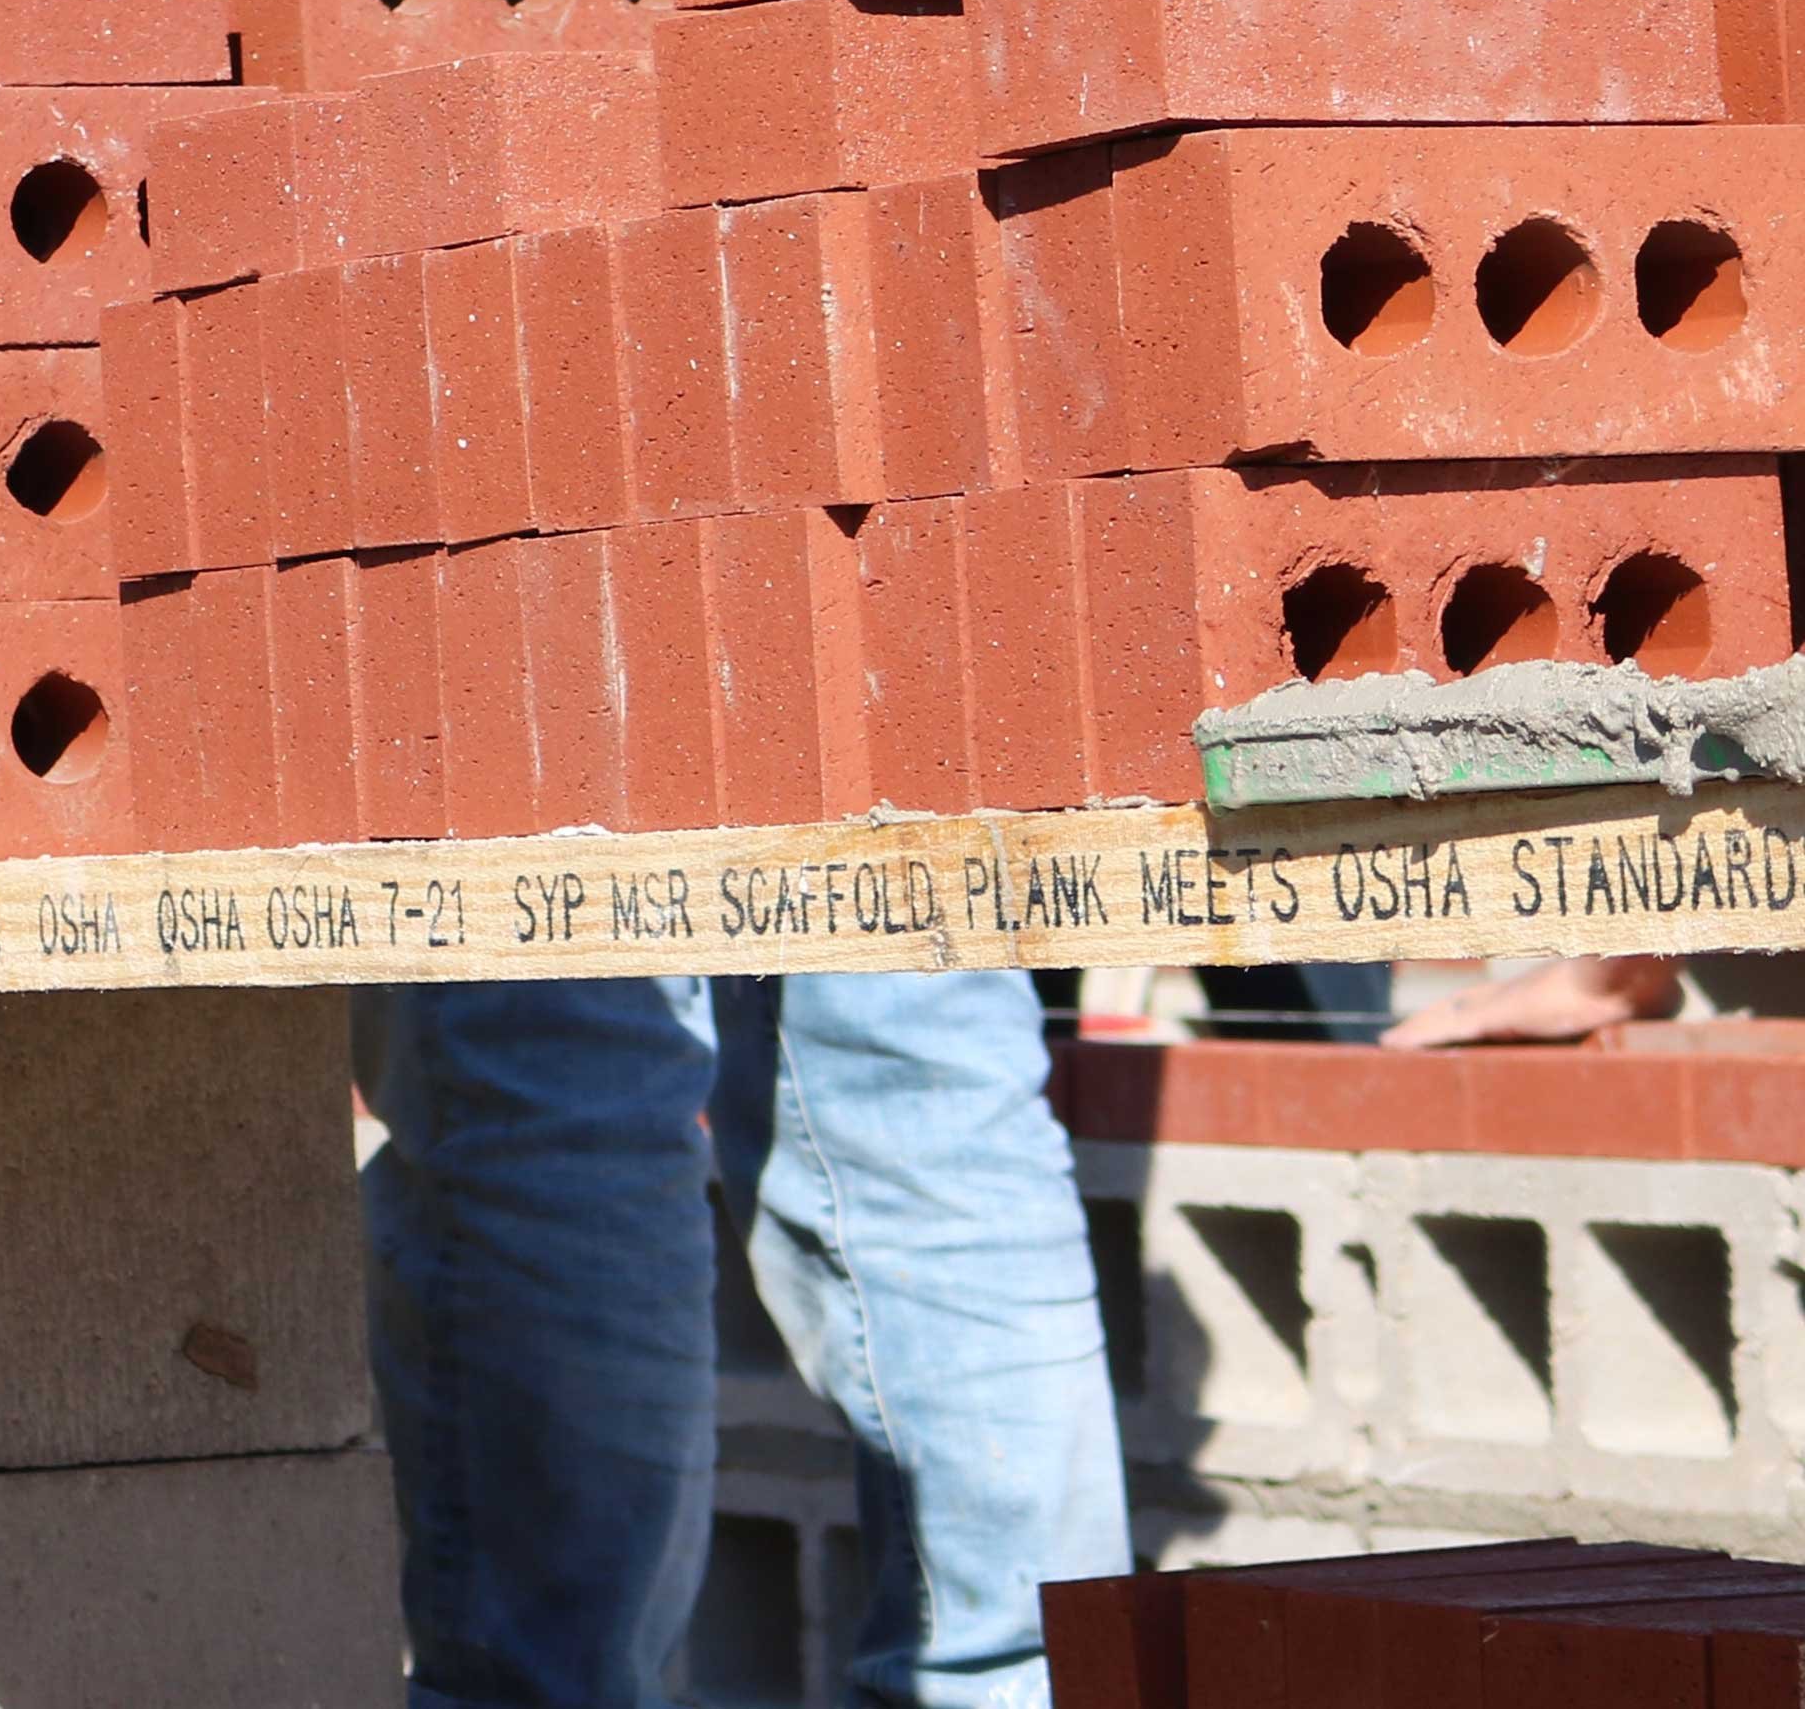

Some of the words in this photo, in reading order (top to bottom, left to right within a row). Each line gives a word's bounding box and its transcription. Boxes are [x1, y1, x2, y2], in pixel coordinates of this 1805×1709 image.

[39, 892, 121, 955] OSHA
[156, 887, 245, 955] OSHA
[267, 882, 359, 948] OSHA
[382, 877, 467, 947] 7-21
[513, 871, 586, 943] SYP
[611, 868, 695, 939] MSR
[719, 859, 940, 937] SCAFFOLD
[964, 853, 1109, 930] PLANK
[1138, 848, 1300, 925] MEETS
[1332, 842, 1473, 921] OSHA
[1512, 826, 1805, 916] STANDARD
